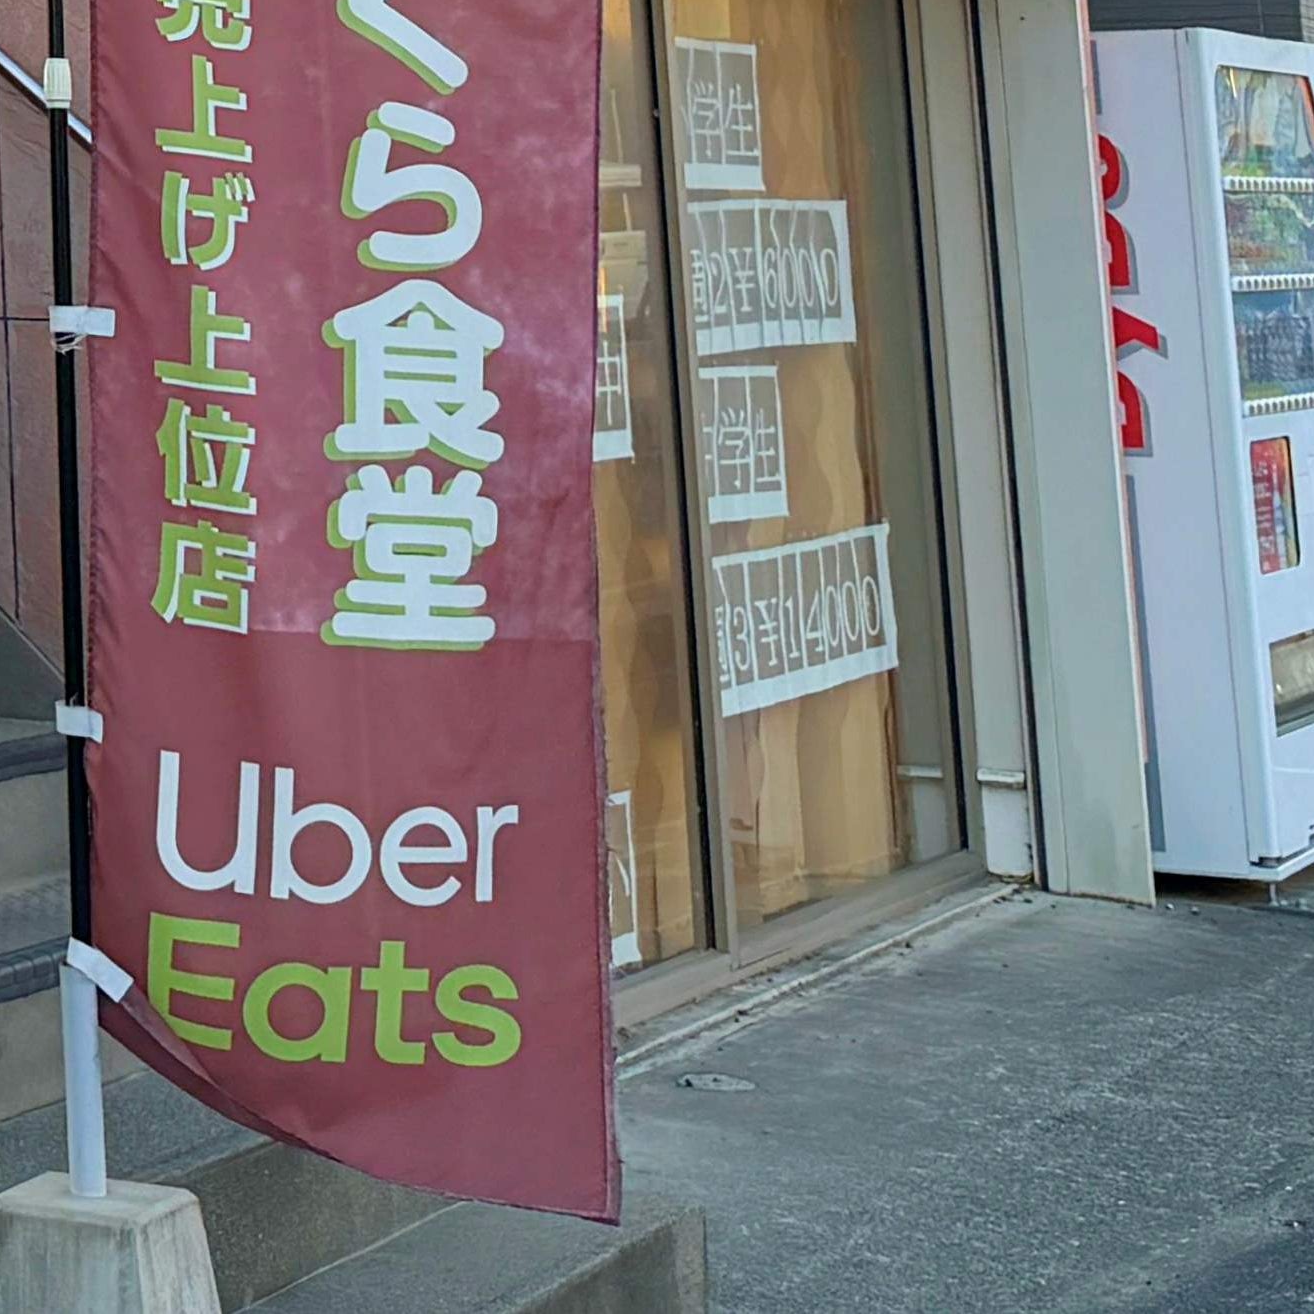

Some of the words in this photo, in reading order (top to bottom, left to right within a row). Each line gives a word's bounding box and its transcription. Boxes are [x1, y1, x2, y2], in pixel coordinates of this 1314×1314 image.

[681, 81, 759, 158] 学生
[702, 405, 782, 490] 学生
[155, 749, 519, 907] Uber
[146, 911, 523, 1068] Eats
